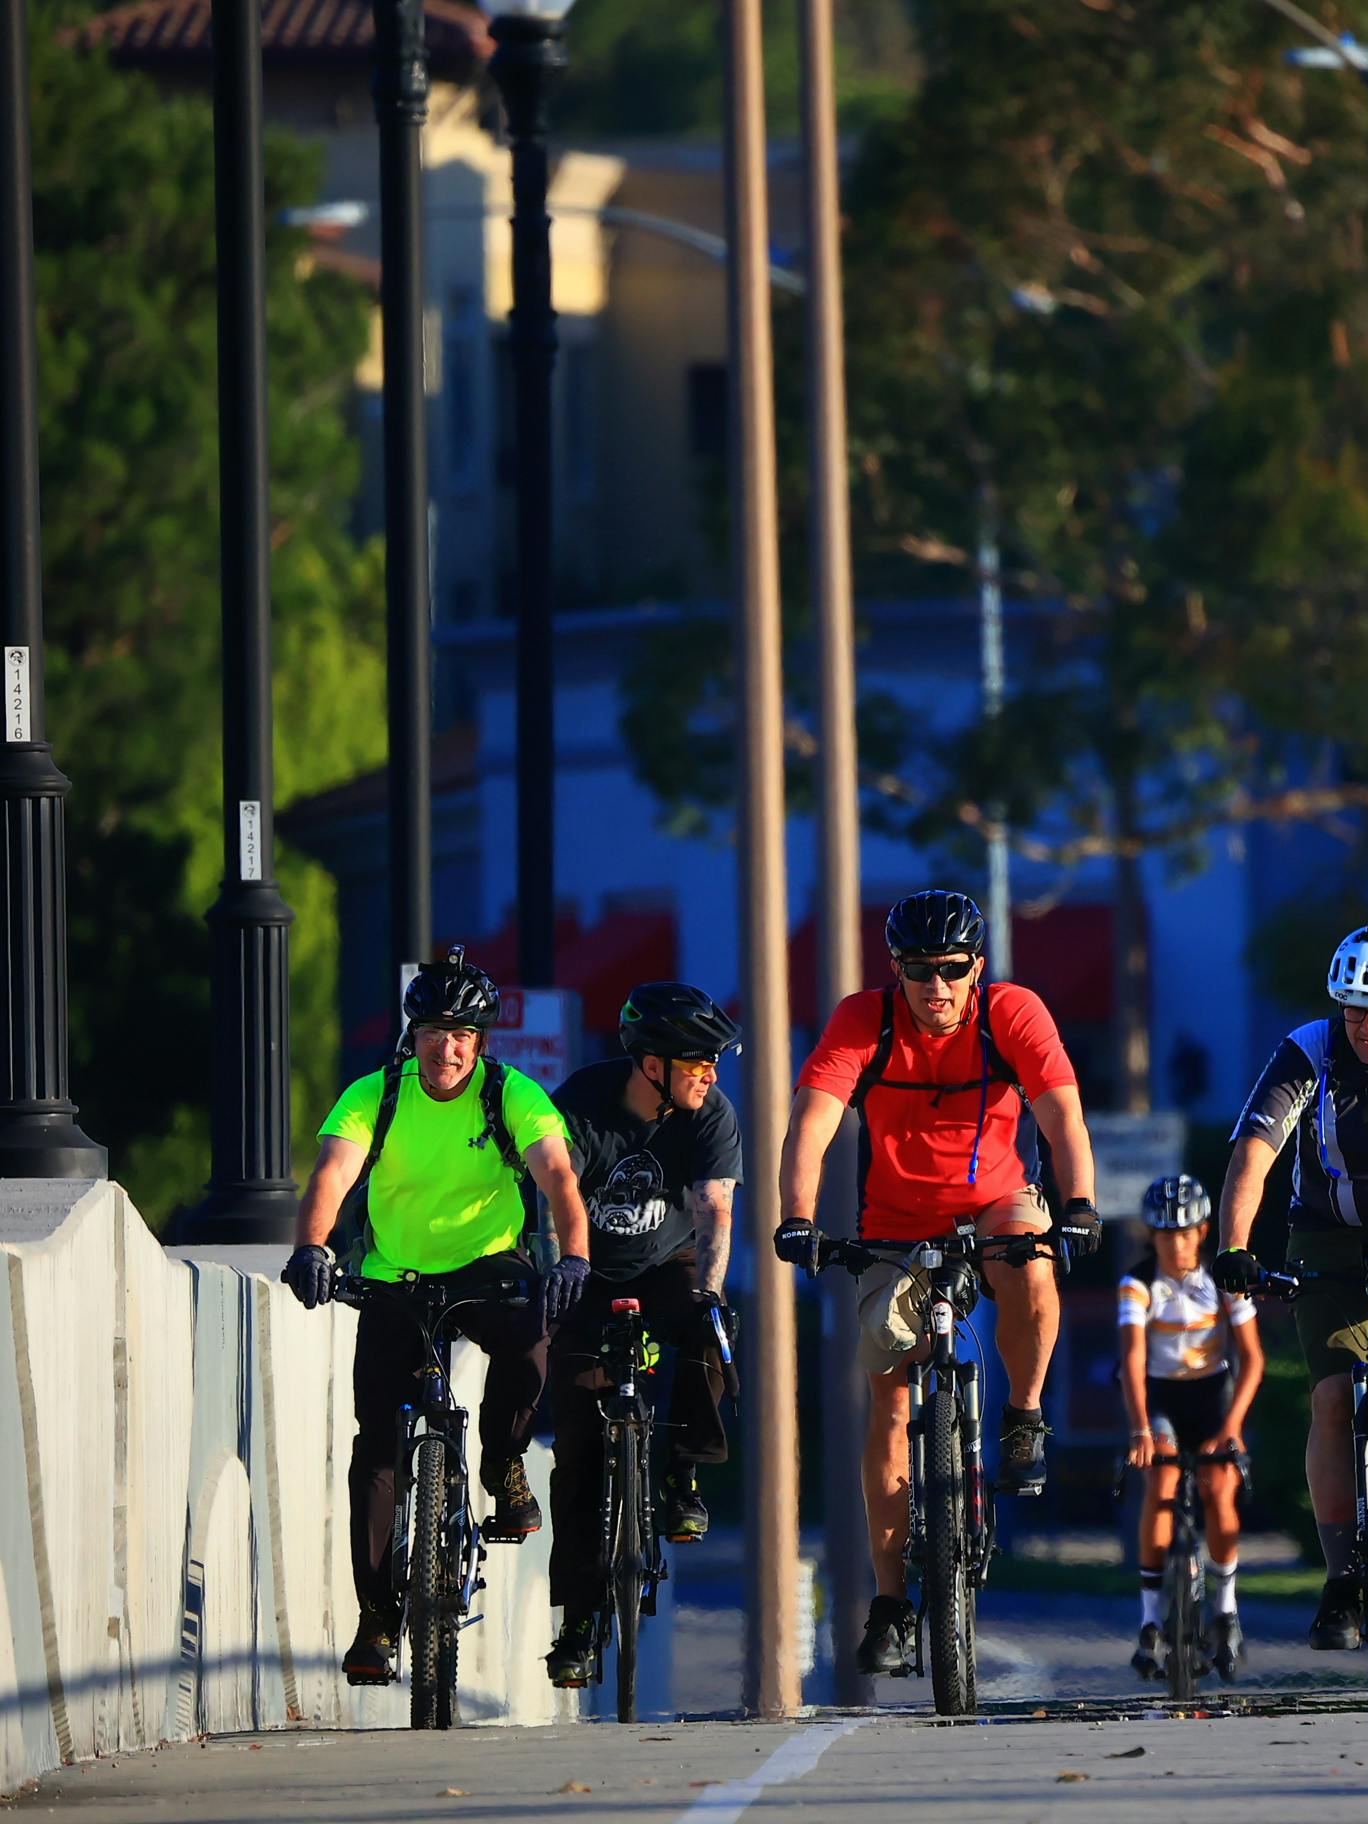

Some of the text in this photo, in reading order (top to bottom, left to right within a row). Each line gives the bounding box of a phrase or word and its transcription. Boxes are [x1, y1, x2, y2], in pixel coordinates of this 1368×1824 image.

[13, 668, 23, 740] 14216
[246, 819, 256, 879] 14217
[782, 1230, 810, 1239] KOBALT
[1061, 1226, 1090, 1236] KOBALT
